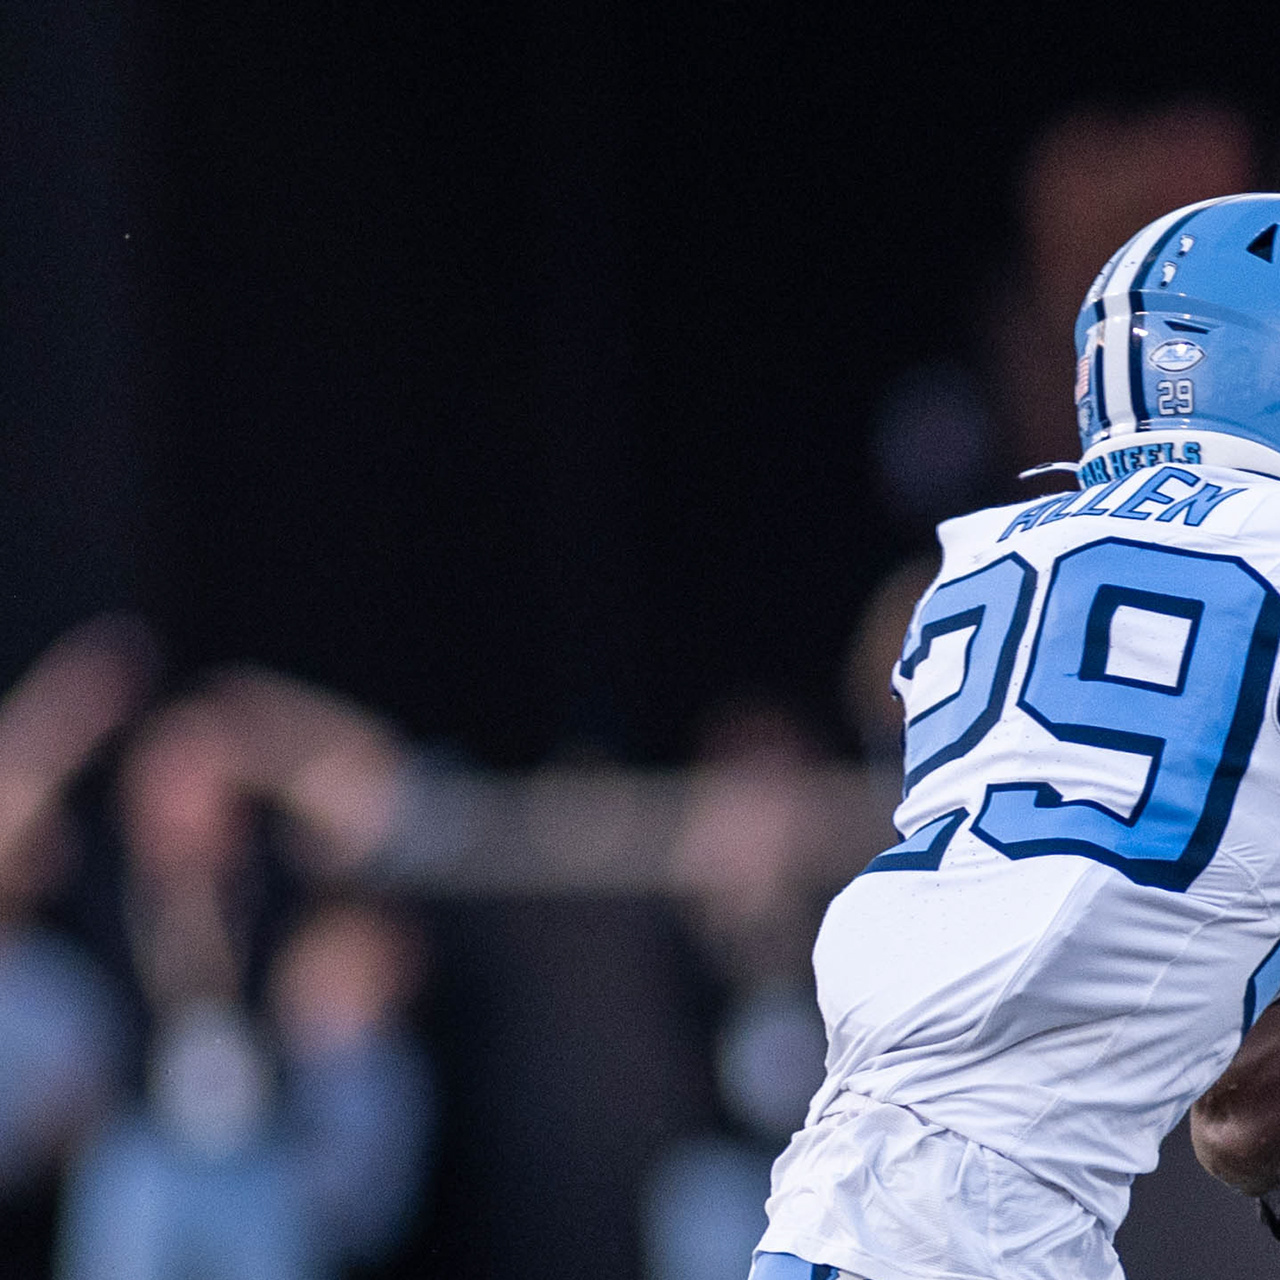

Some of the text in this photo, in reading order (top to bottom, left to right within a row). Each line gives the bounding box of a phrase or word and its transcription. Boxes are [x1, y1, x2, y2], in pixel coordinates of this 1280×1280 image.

[1157, 378, 1194, 415] 29
[1107, 442, 1202, 480] HEELS
[996, 466, 1248, 543] ALLEN
